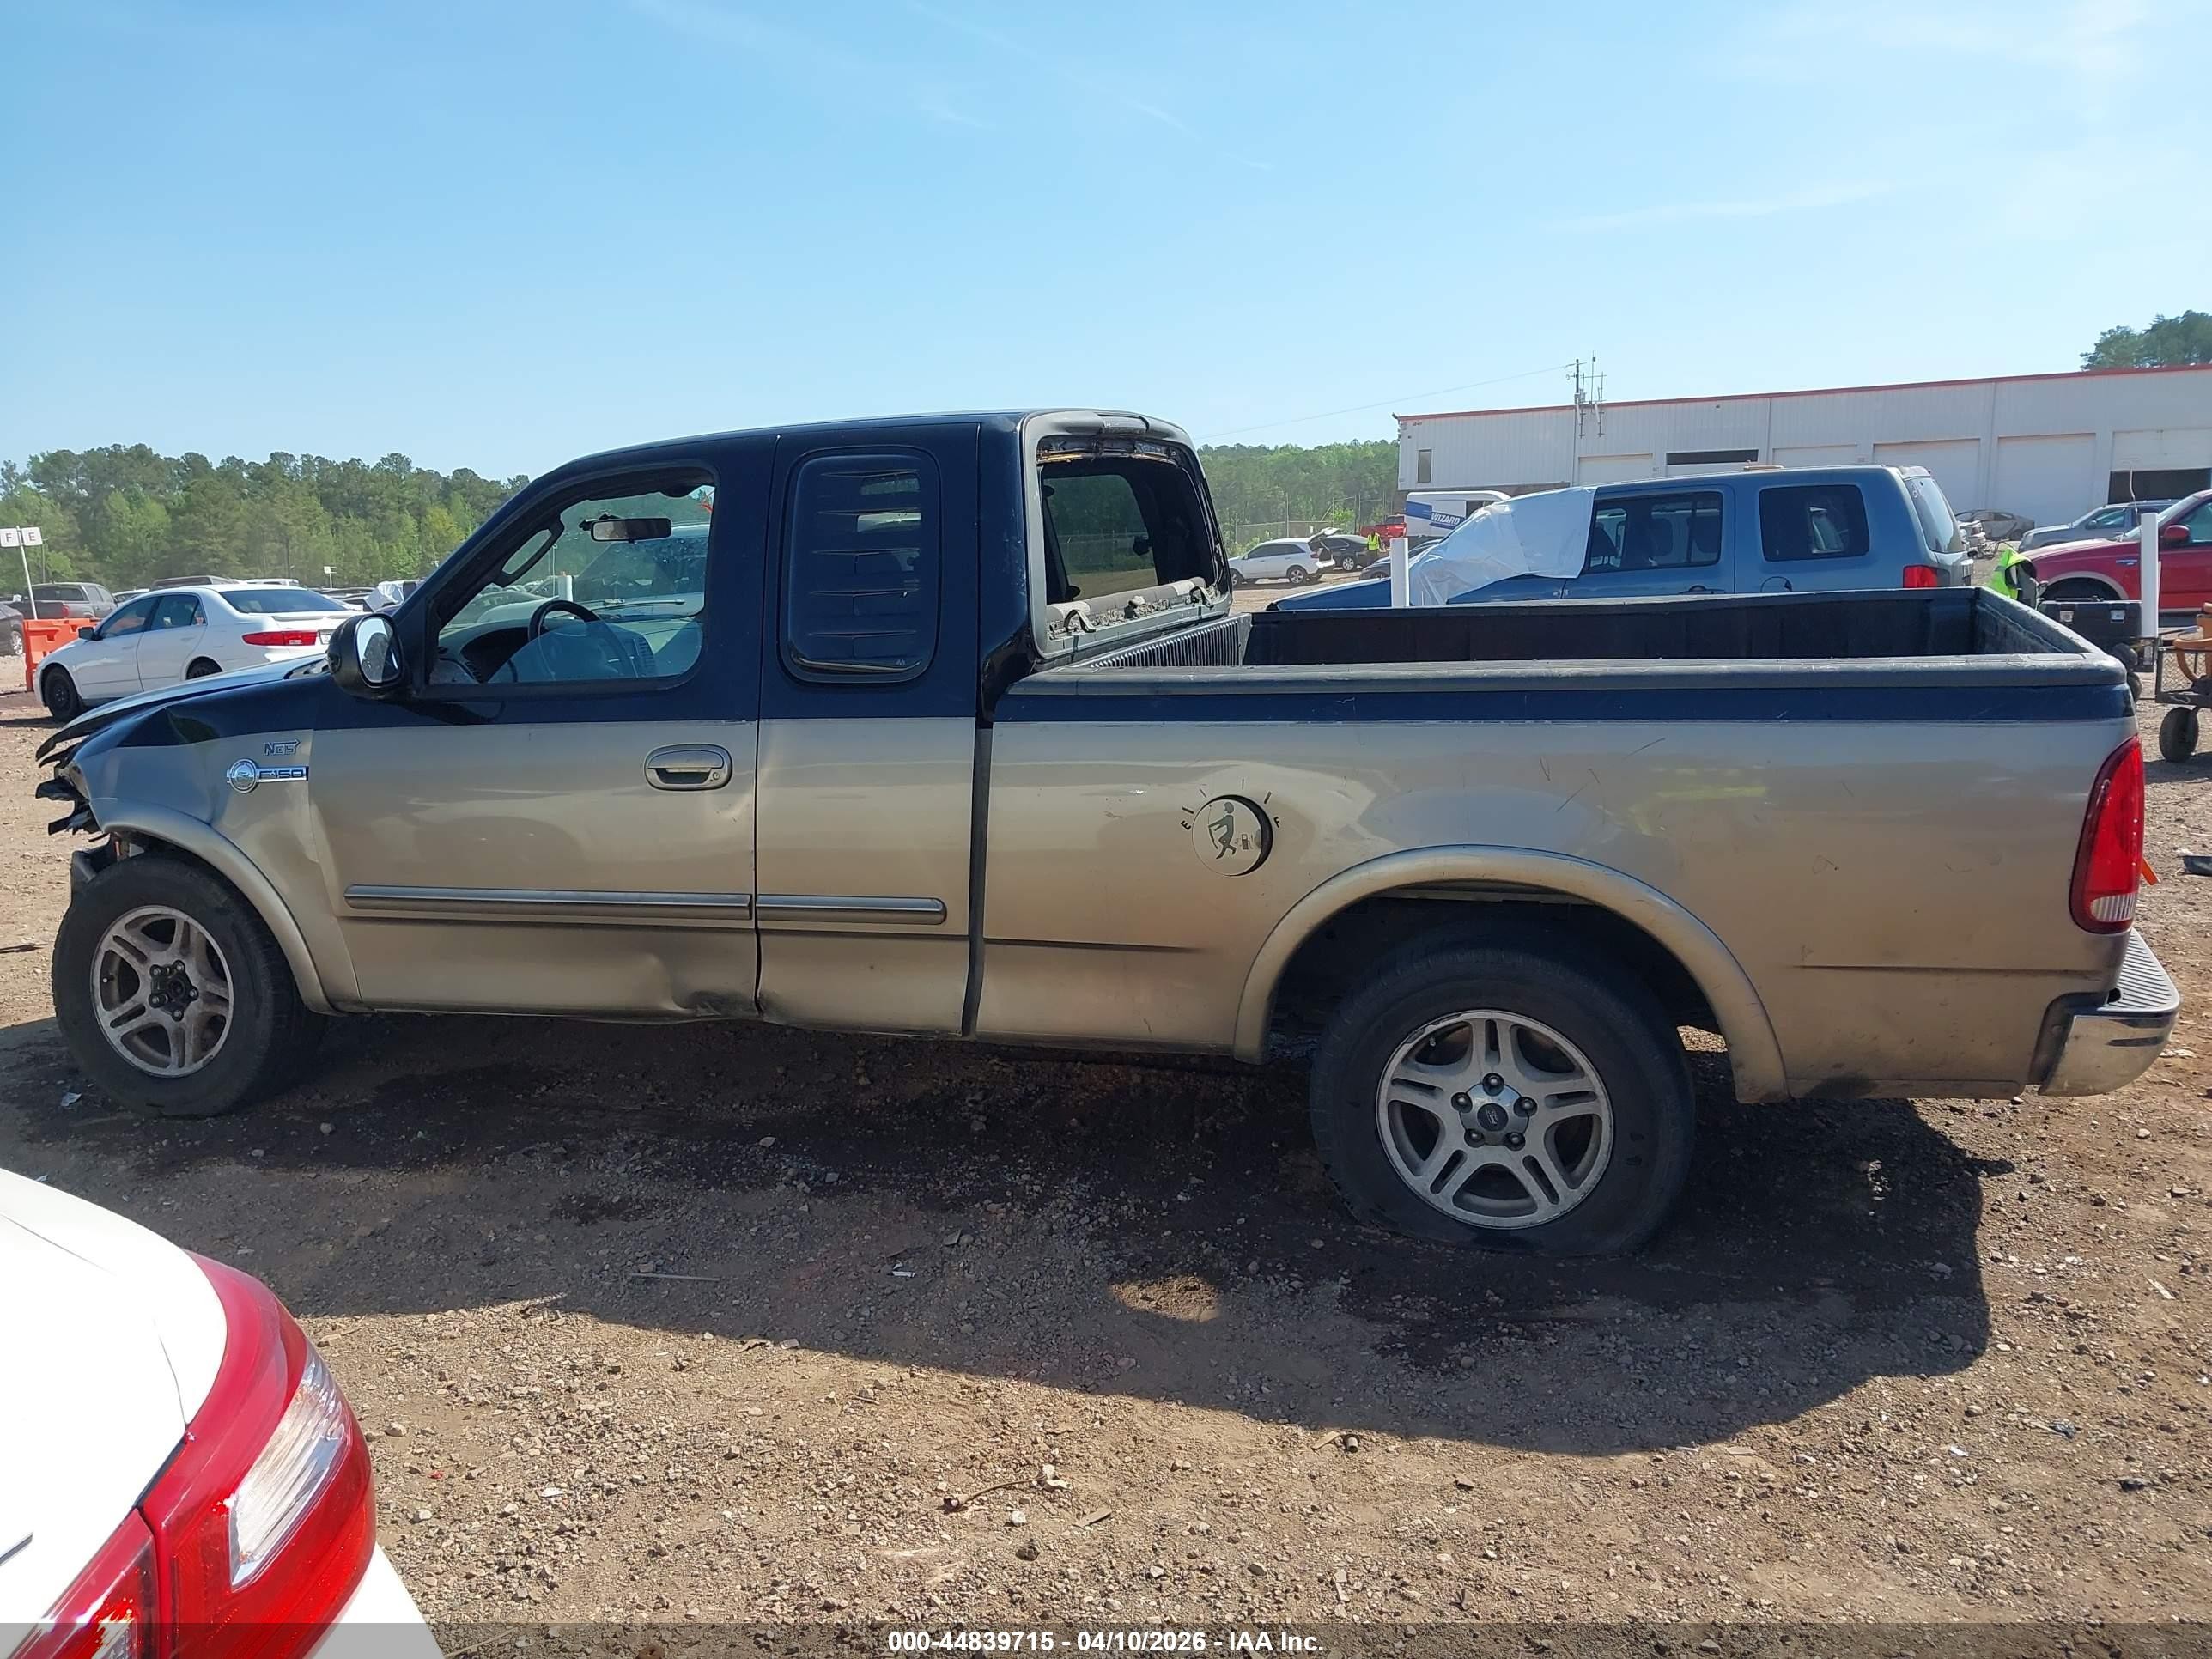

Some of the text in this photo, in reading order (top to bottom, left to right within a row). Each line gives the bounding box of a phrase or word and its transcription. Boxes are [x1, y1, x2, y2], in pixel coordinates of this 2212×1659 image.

[1431, 513, 1461, 526] WIZARD
[5, 532, 13, 543] F
[28, 532, 36, 542] E
[1180, 820, 1192, 831] E
[1273, 816, 1281, 829] F
